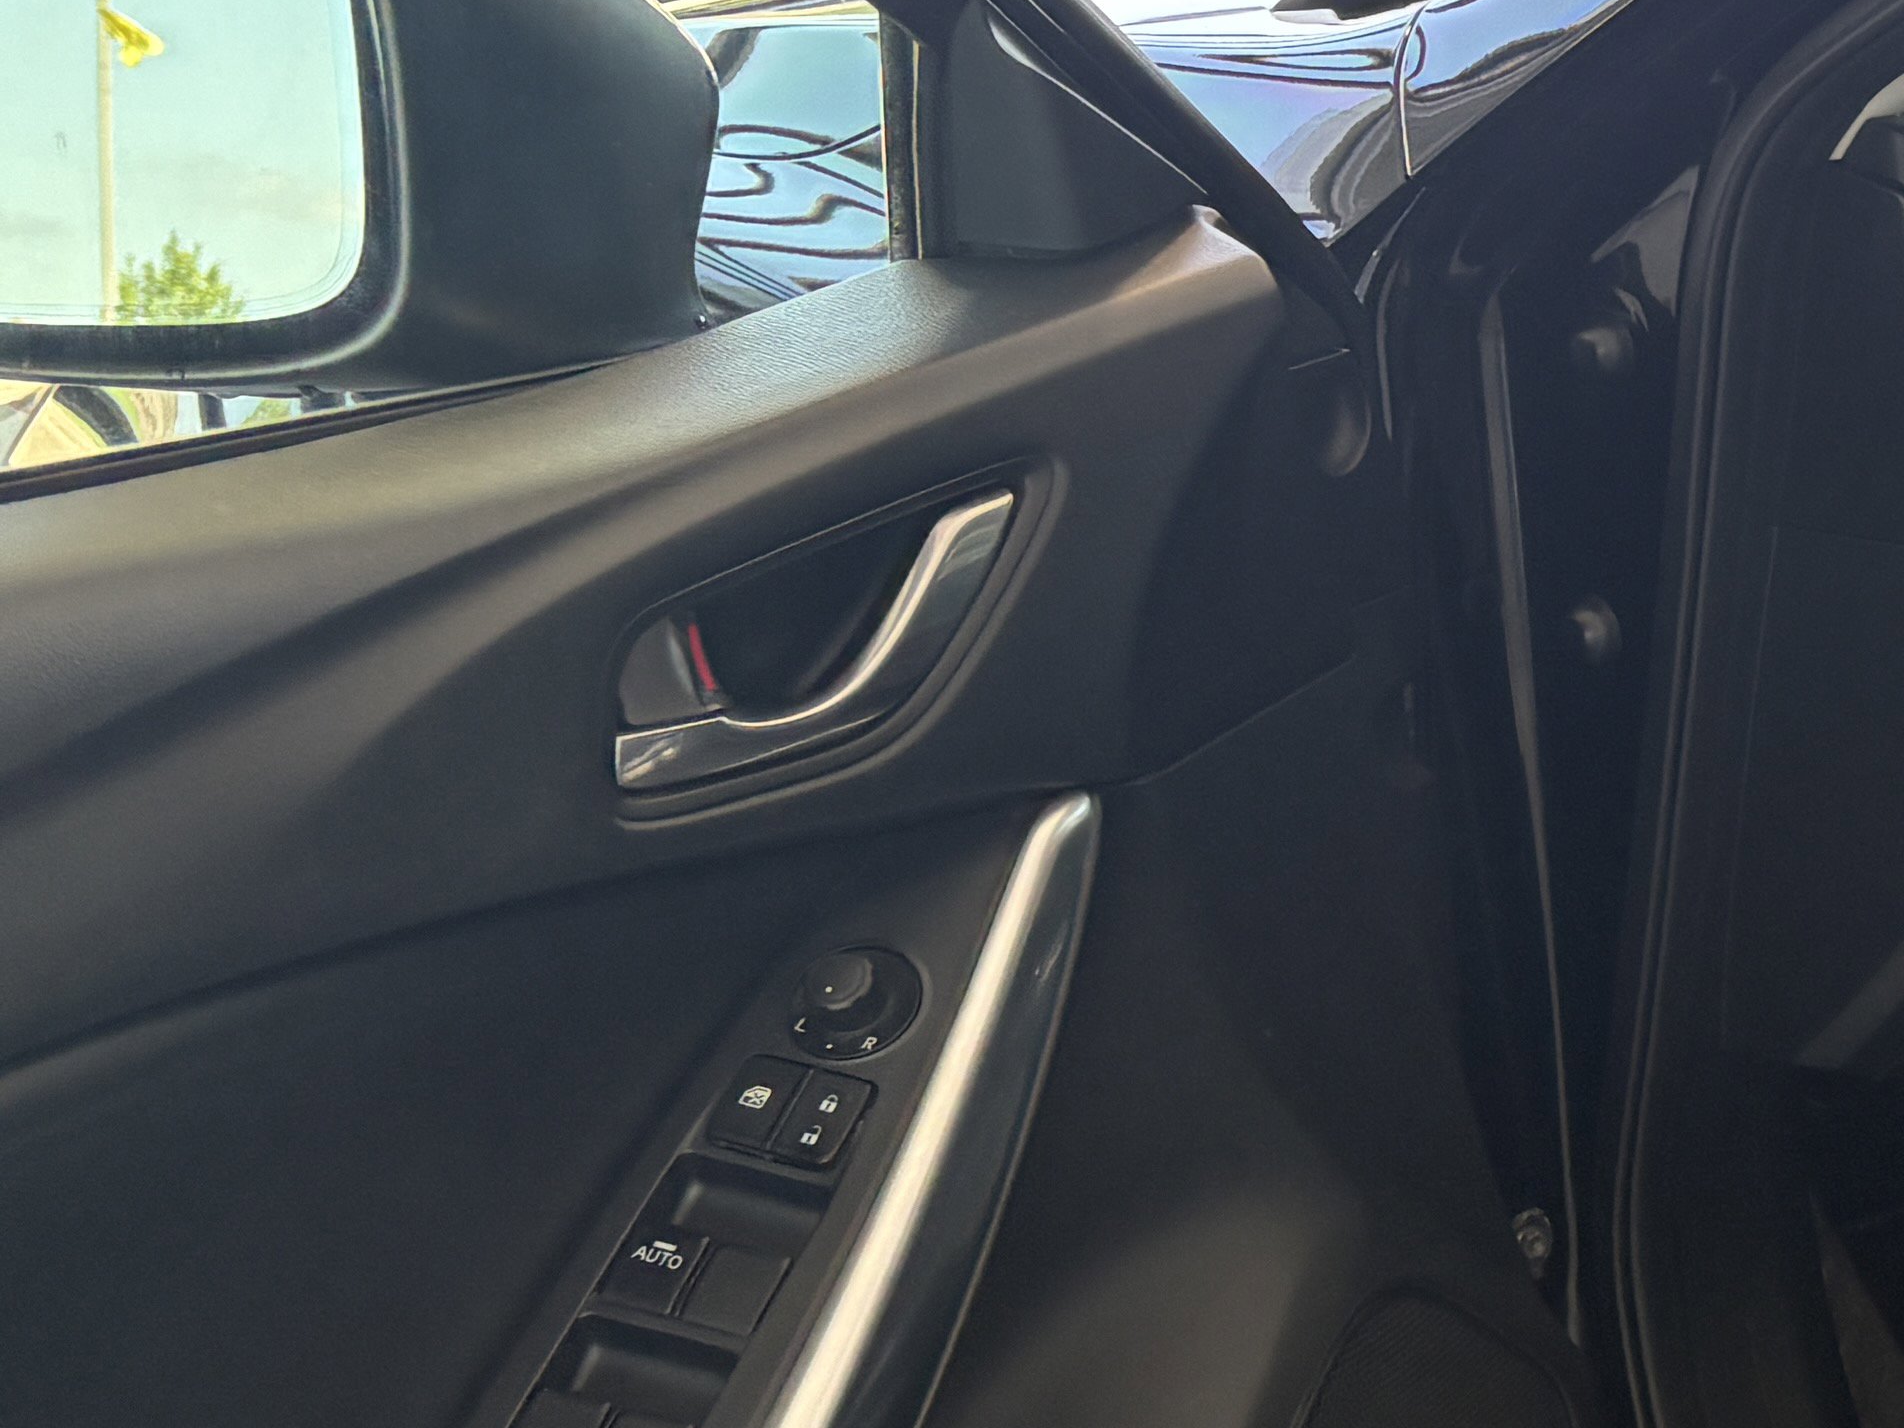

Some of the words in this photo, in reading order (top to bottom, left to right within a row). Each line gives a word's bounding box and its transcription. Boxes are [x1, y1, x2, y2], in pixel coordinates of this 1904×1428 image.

[793, 1017, 806, 1033] L
[860, 1036, 878, 1051] R
[630, 1245, 684, 1270] AUTO
